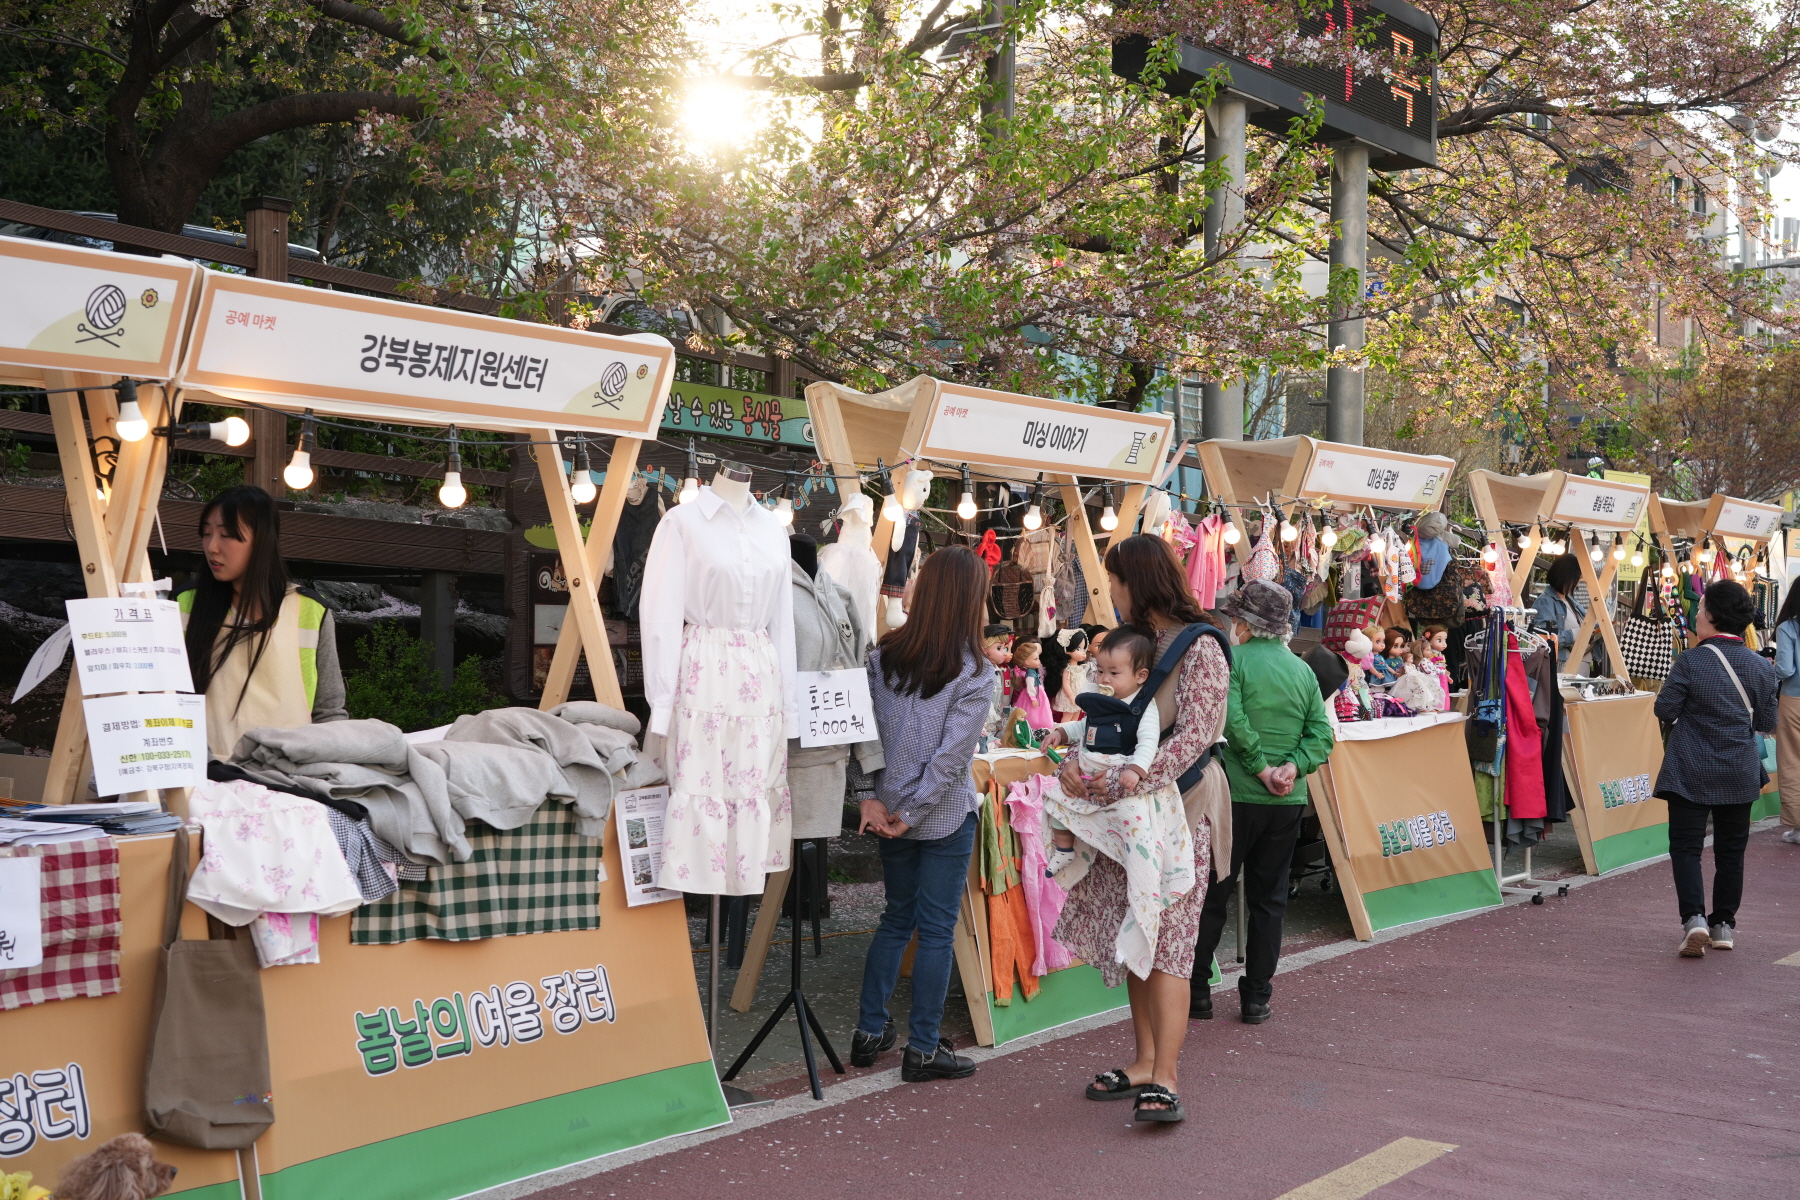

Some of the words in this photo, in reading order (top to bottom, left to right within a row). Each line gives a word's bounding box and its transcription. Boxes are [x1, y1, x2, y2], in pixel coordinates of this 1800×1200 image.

[225, 310, 250, 327] 공예
[252, 314, 277, 331] 마켓
[360, 334, 549, 393] 강북봉제지원센터
[659, 392, 685, 426] 날
[690, 396, 703, 427] 수
[709, 399, 734, 431] 있는
[741, 395, 783, 441] 동식물
[1022, 420, 1049, 449] 미싱
[1049, 426, 1089, 454] 이야기
[1382, 470, 1400, 491] 공방
[809, 685, 852, 717] 후드티
[142, 737, 175, 748] 계좌번호
[120, 754, 137, 764] 신한
[540, 963, 616, 1035] 장터
